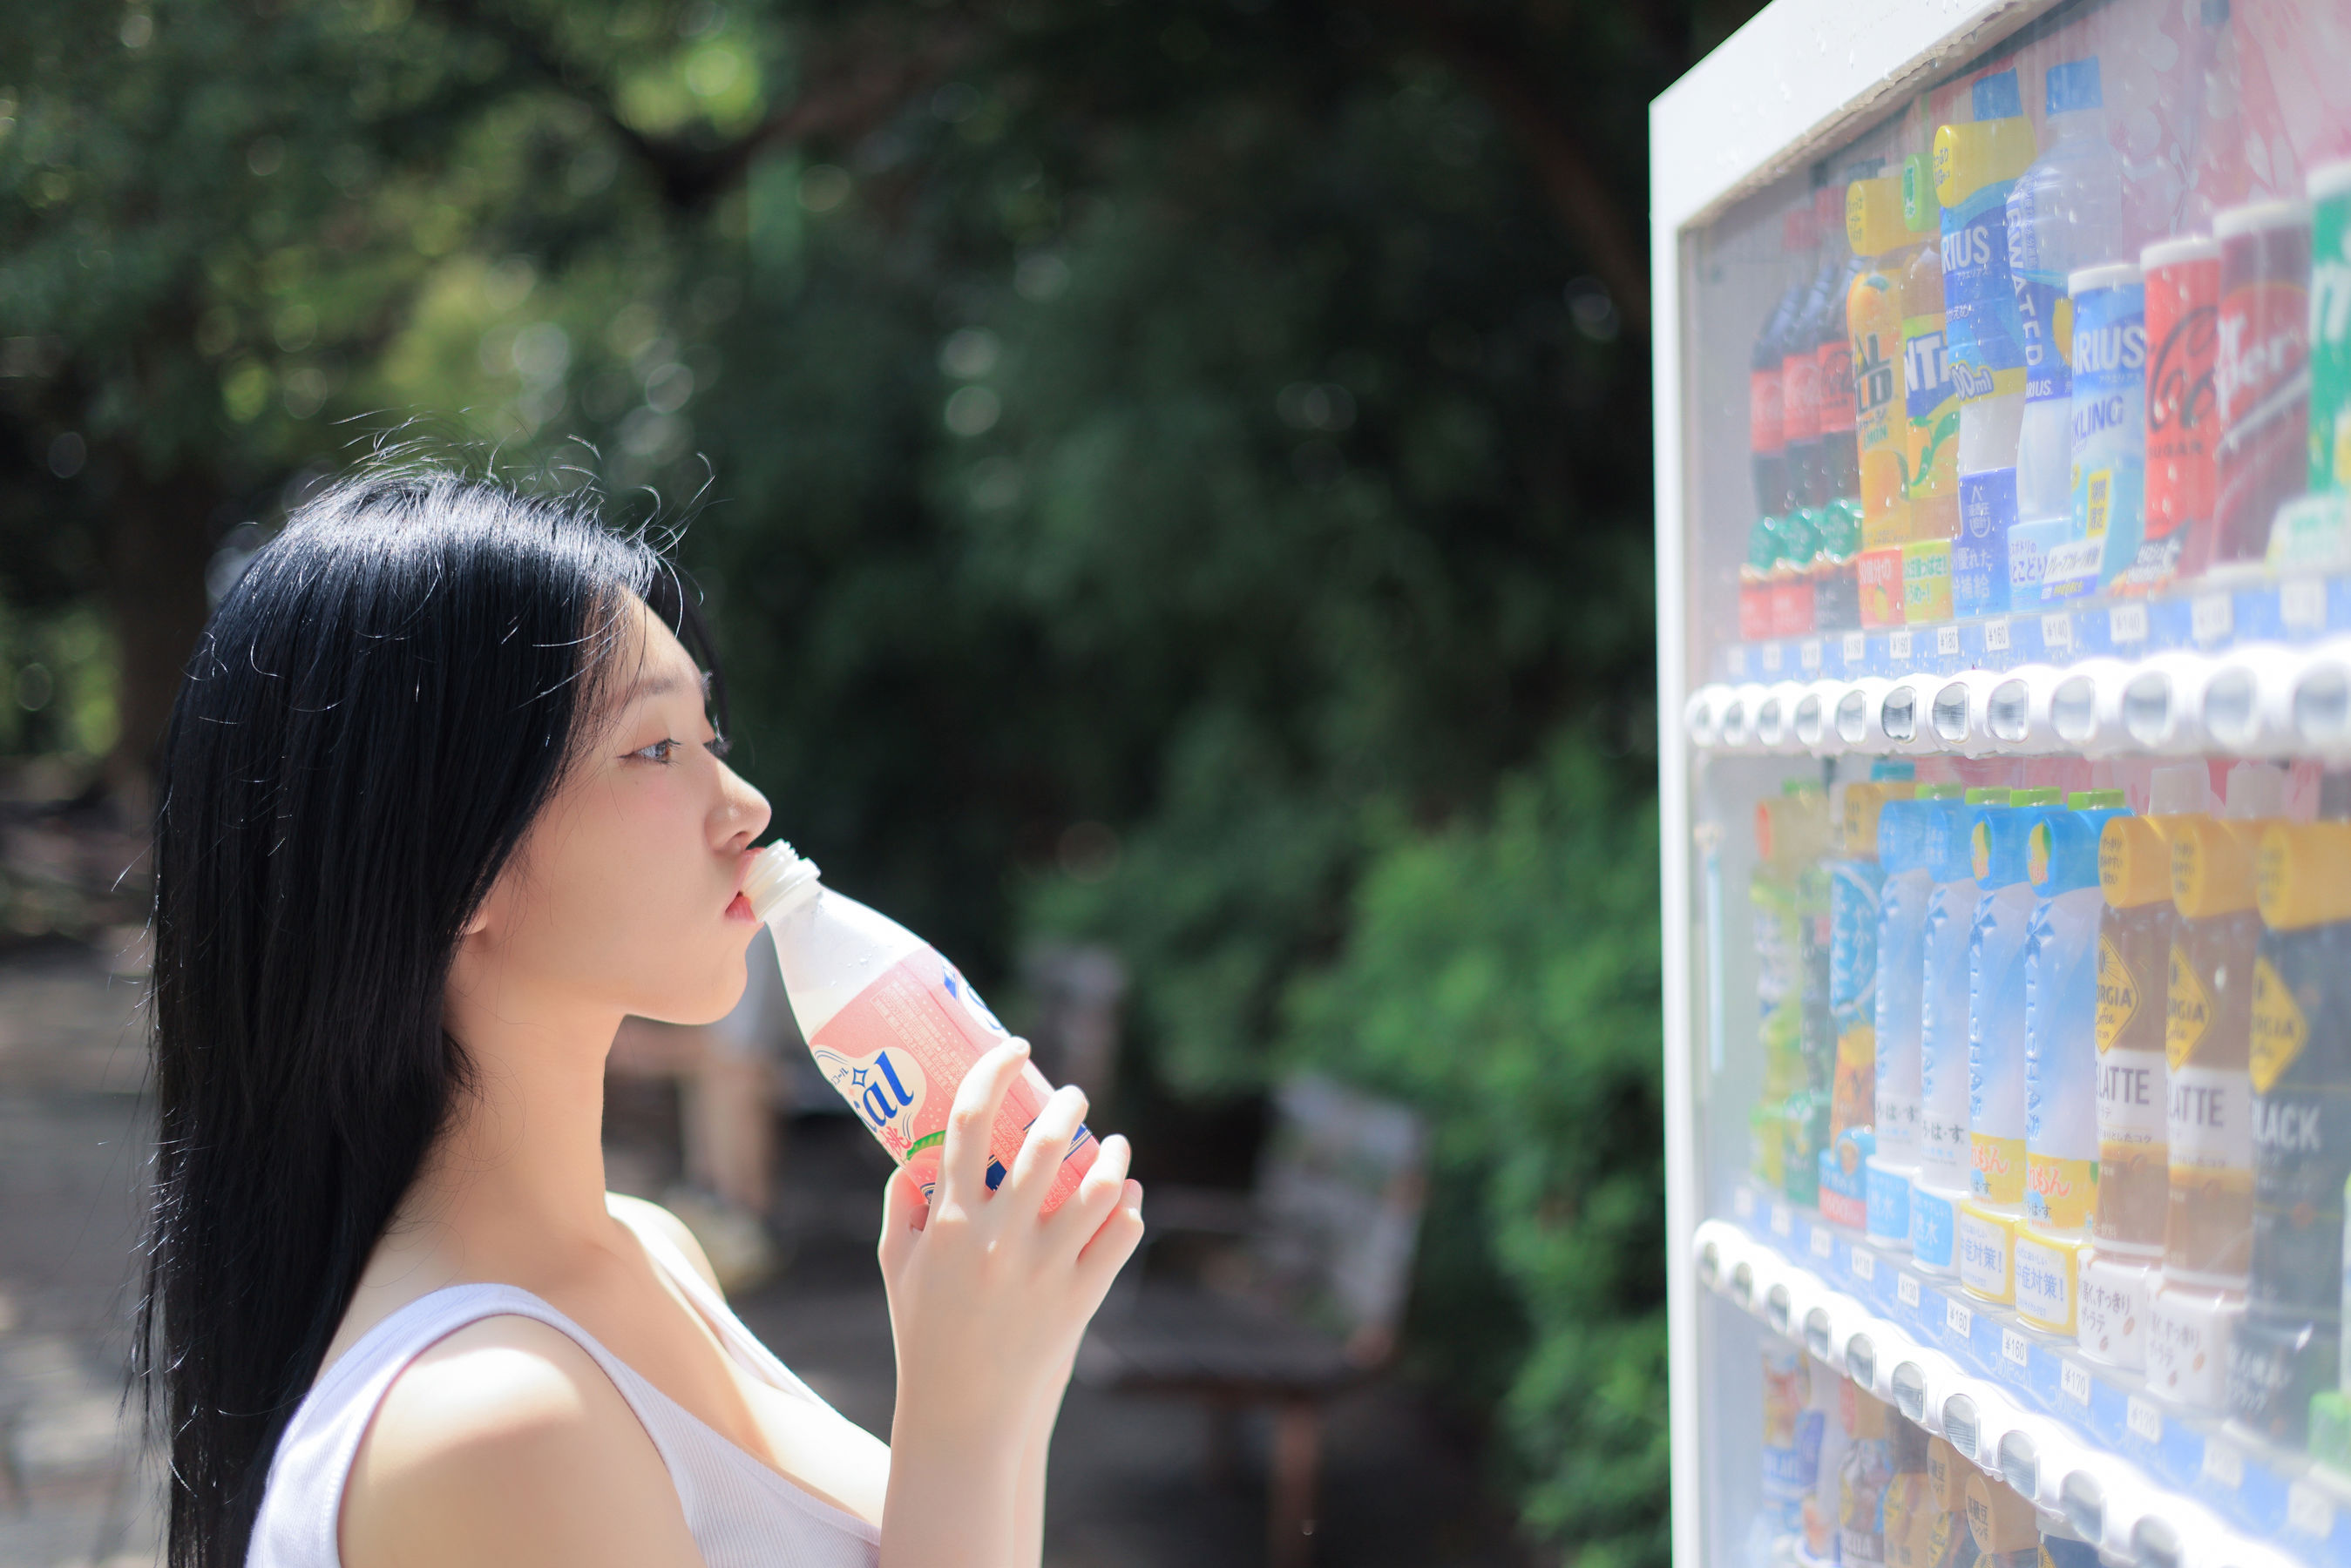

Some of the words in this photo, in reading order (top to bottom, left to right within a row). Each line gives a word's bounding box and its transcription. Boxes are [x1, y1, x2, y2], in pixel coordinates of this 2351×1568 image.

[1949, 1308, 1968, 1332] ¥160
[2005, 1336, 2025, 1361] ¥160
[2063, 1366, 2087, 1395] ¥170
